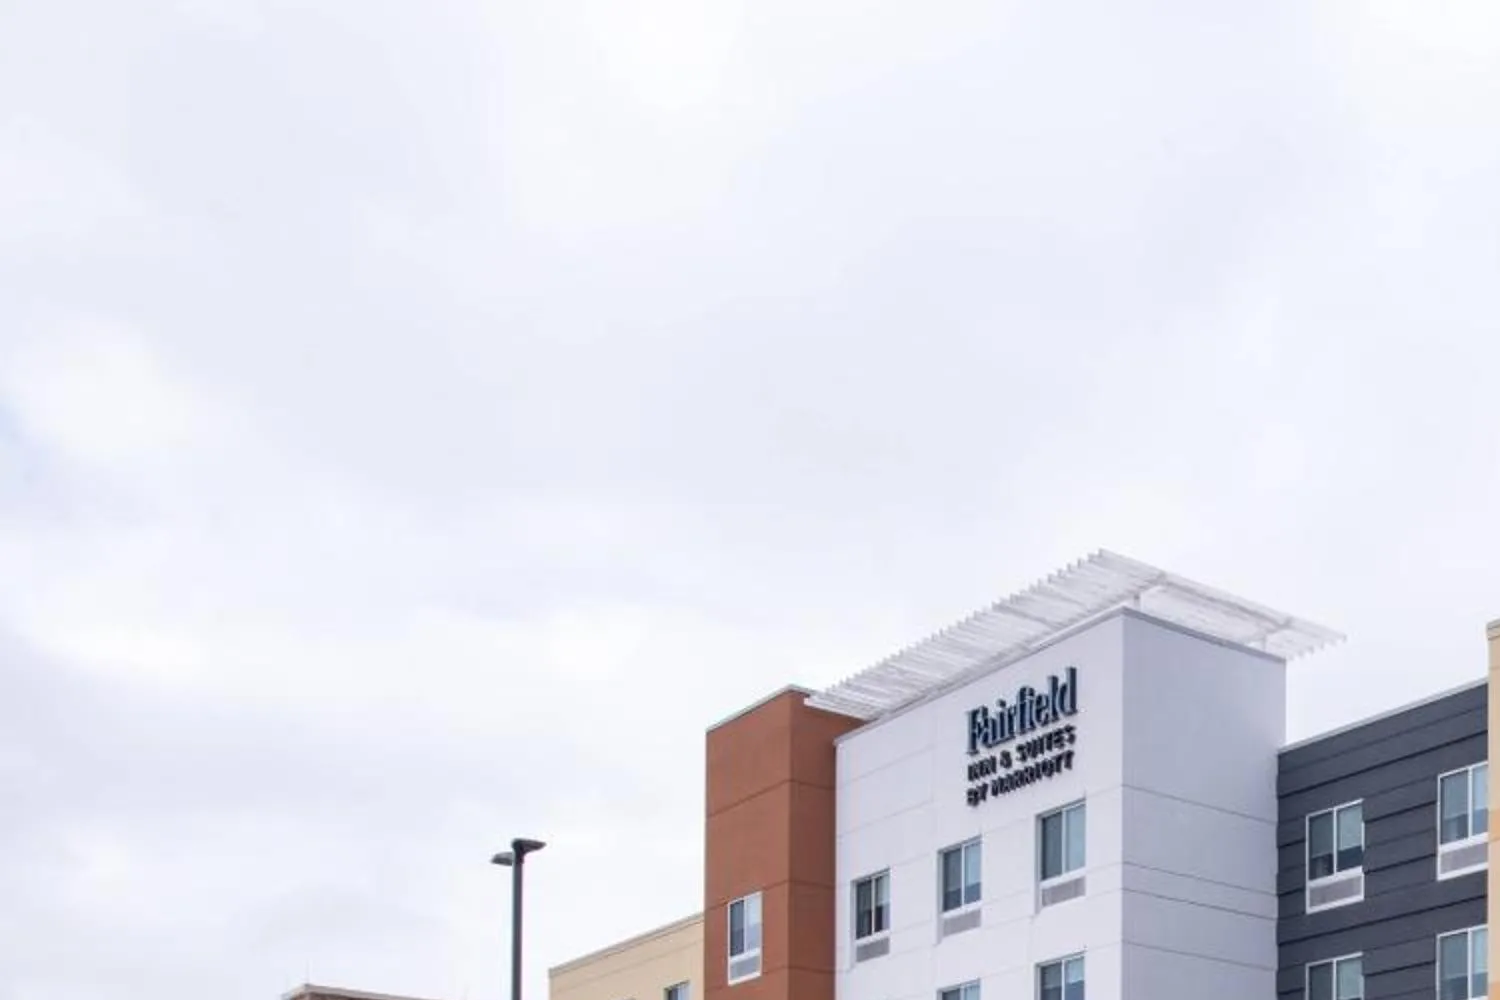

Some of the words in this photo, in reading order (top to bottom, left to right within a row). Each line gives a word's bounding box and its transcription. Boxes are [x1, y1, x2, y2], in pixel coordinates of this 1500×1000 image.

[966, 667, 1078, 755] Fairfield
[966, 783, 988, 807] BY
[991, 750, 1075, 797] MARRIOTT
[967, 756, 997, 782] INN
[1000, 750, 1012, 769] &
[1016, 724, 1076, 762] SUITES
